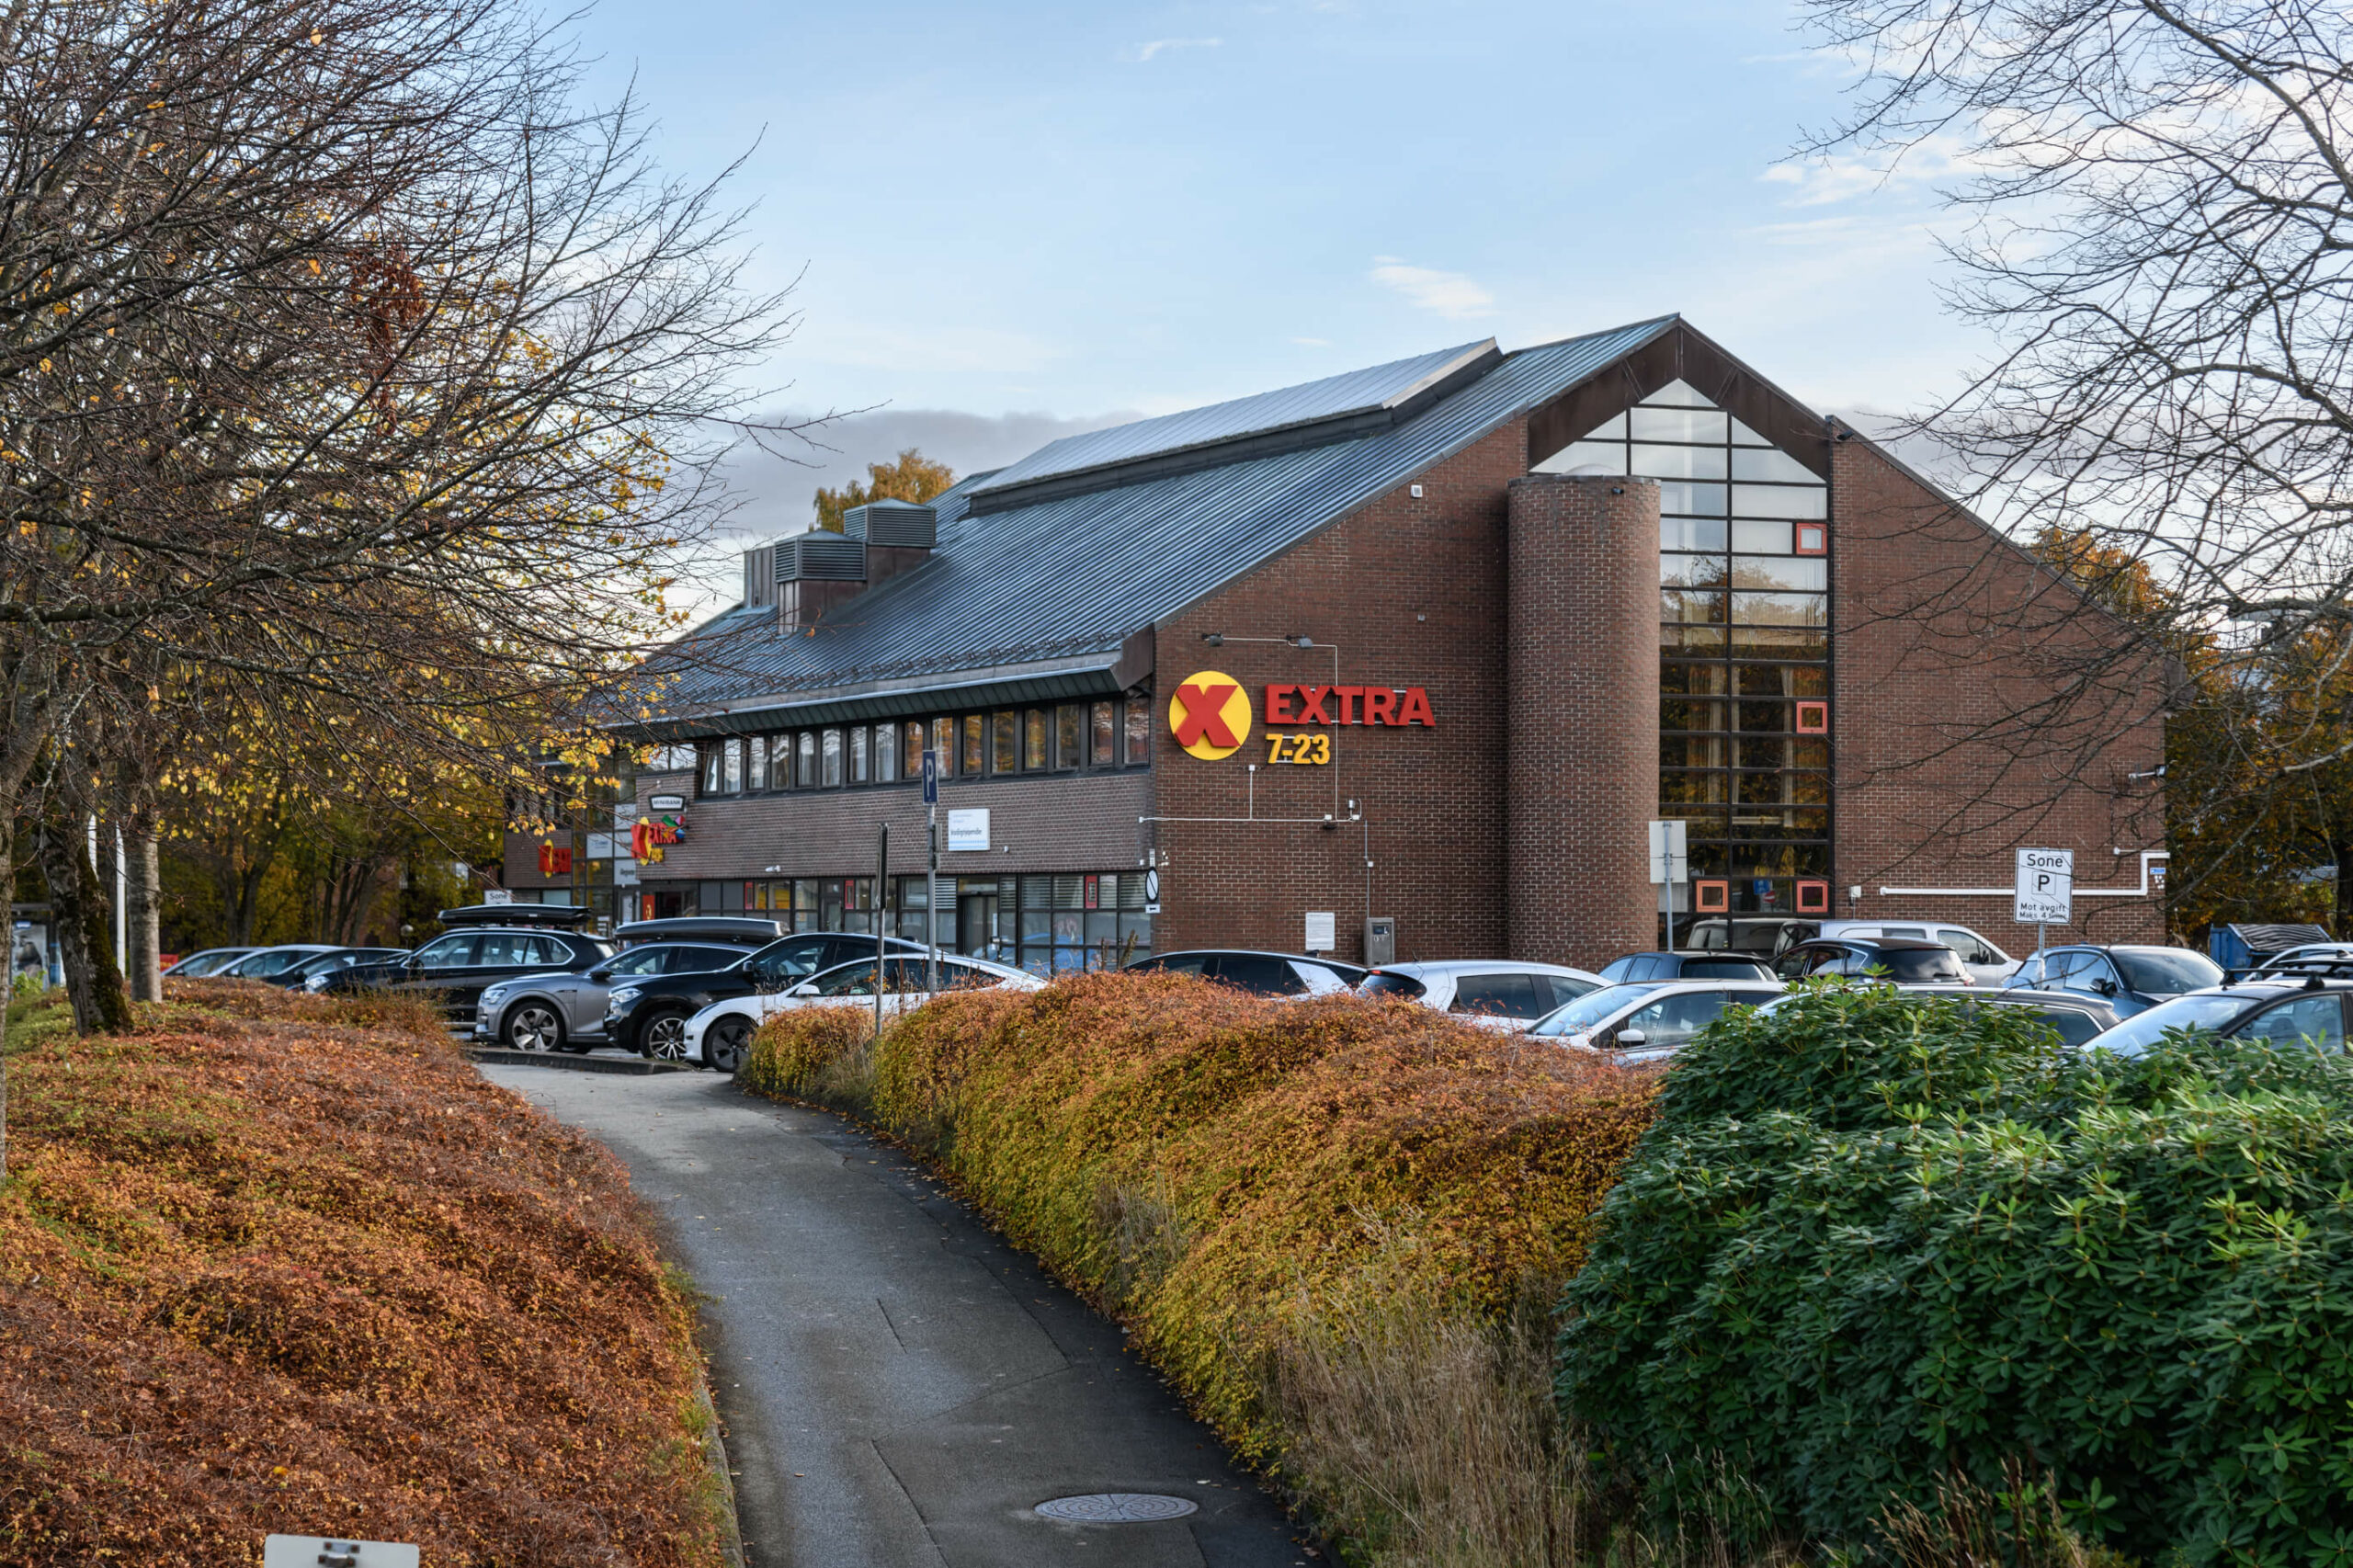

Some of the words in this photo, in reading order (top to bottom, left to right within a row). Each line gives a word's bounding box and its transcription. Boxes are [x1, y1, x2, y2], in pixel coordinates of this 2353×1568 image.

[1265, 684, 1436, 726] EXTRA
[1266, 733, 1330, 765] 7-23
[926, 758, 934, 797] P
[2027, 853, 2063, 867] Sone
[2038, 874, 2051, 892] P
[2020, 902, 2037, 911] Mot
[2040, 903, 2065, 913] avgift
